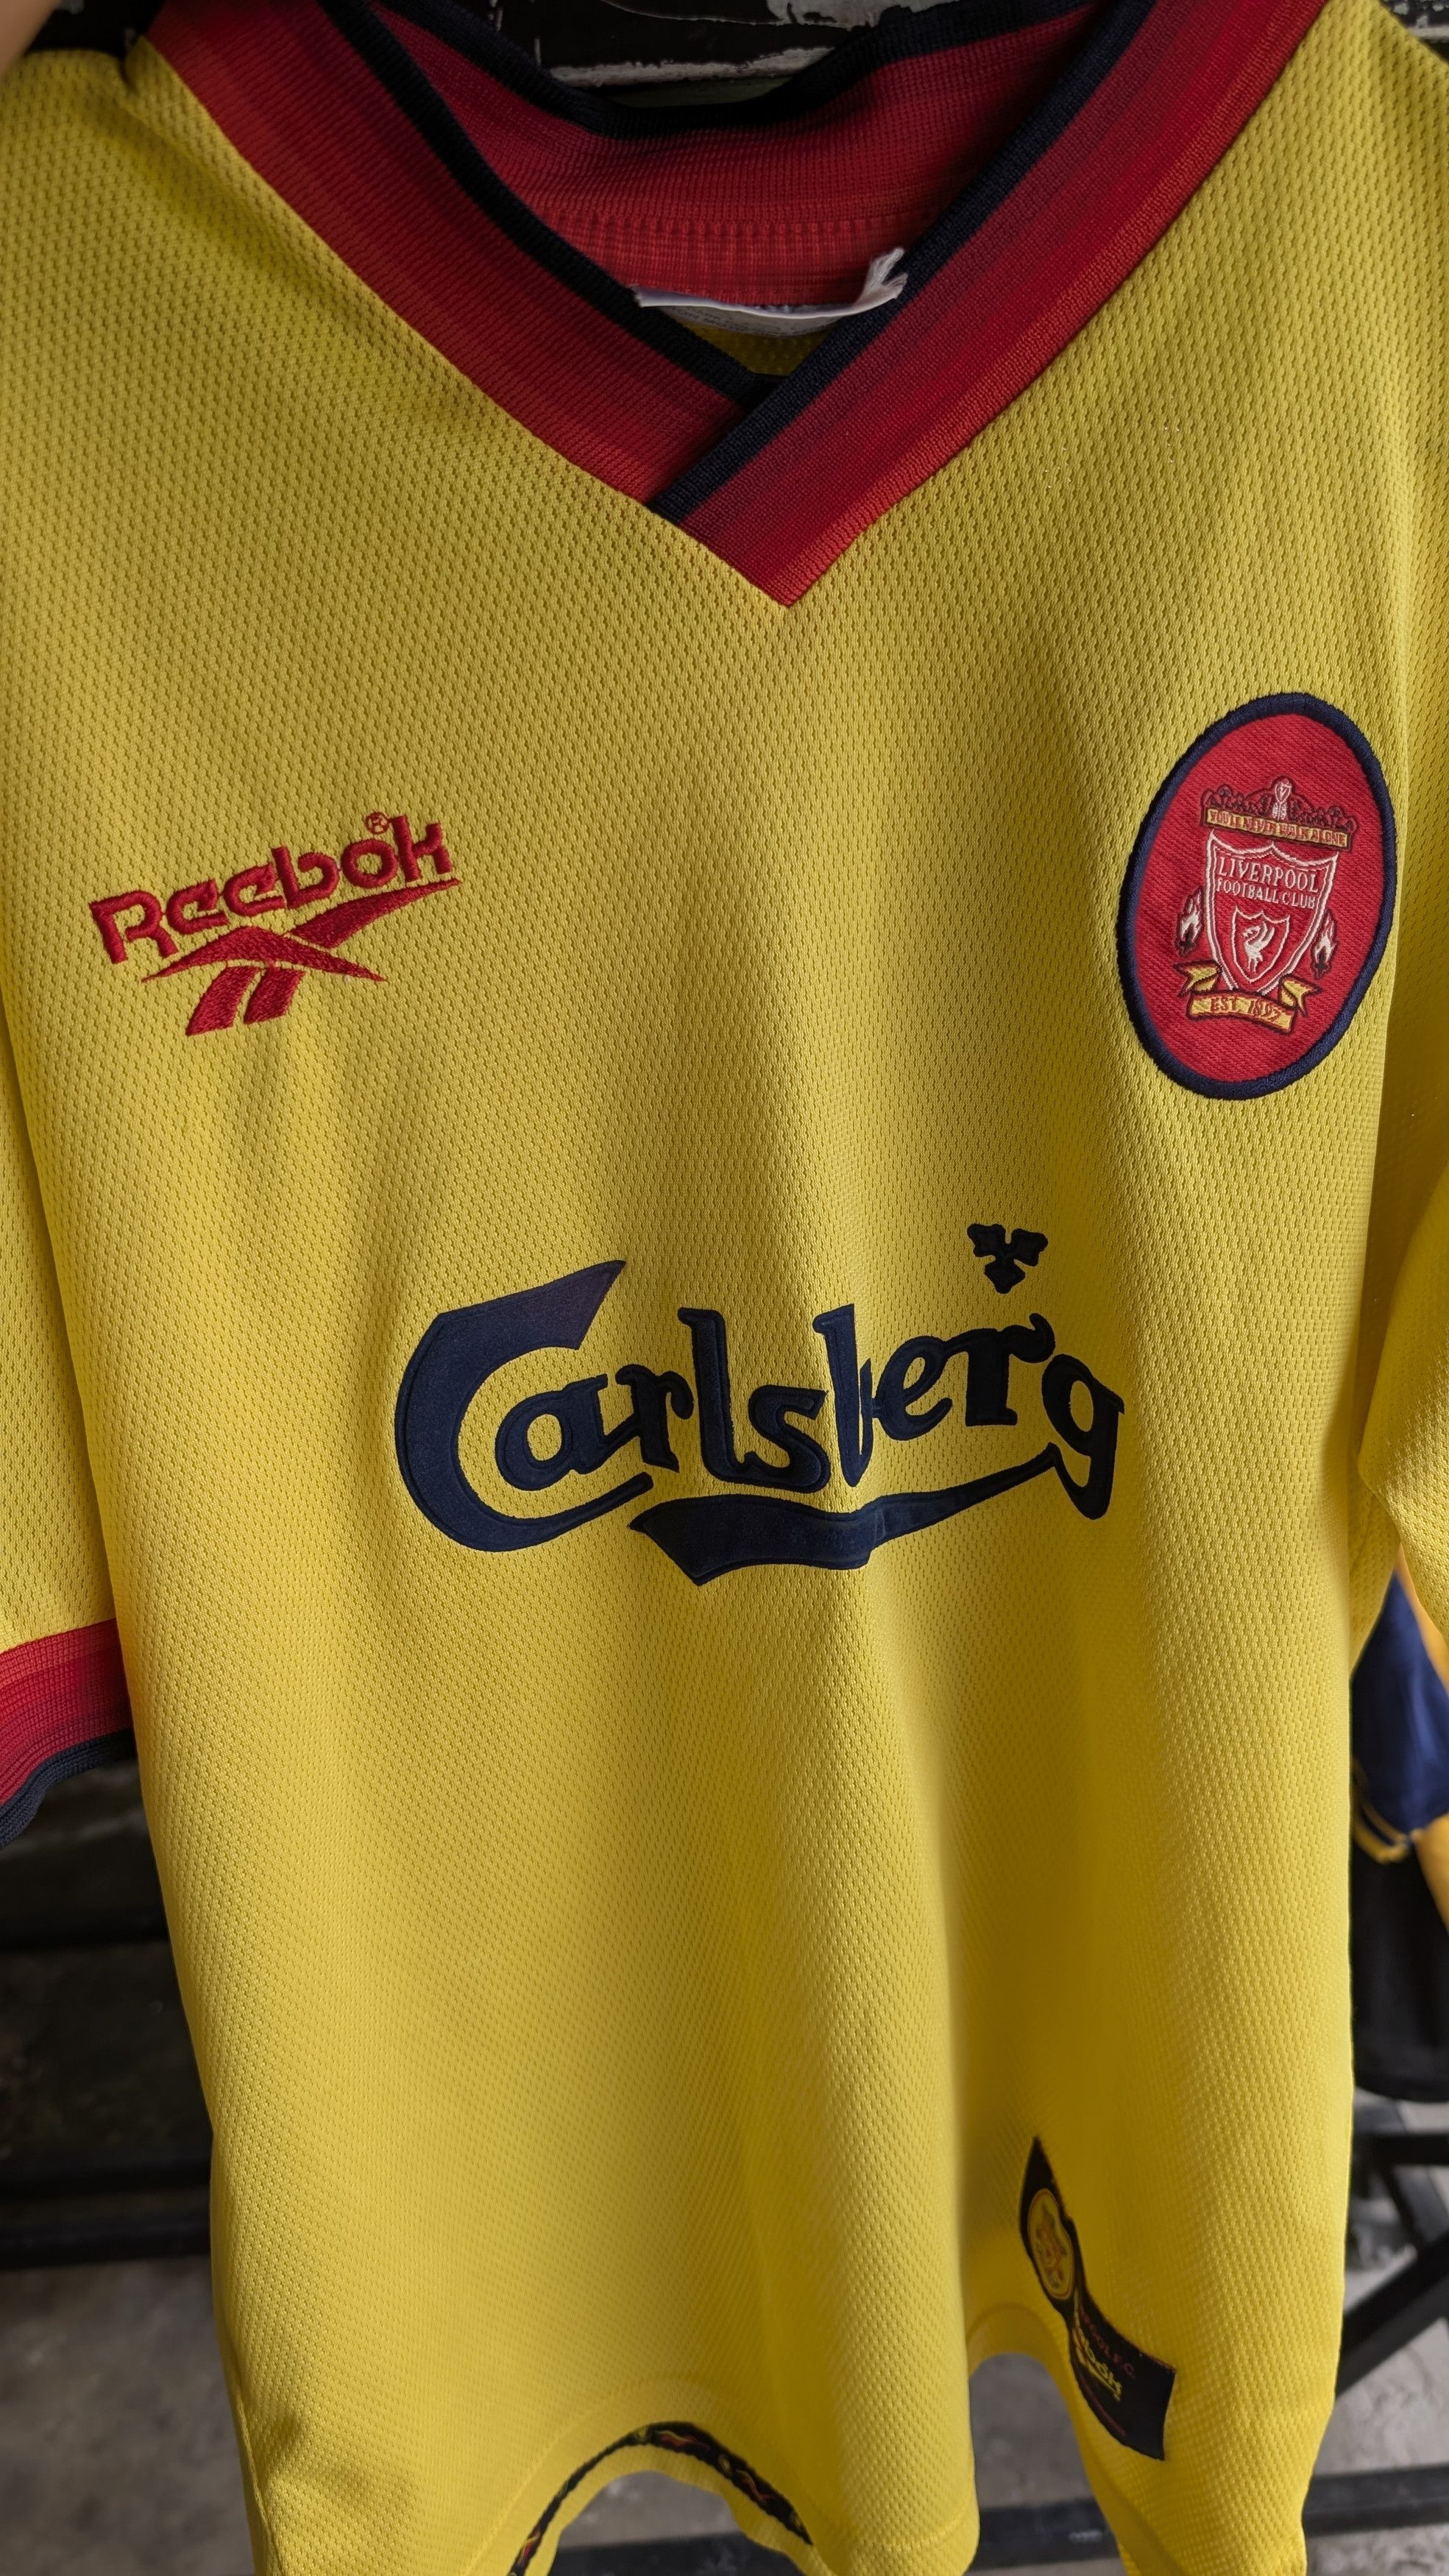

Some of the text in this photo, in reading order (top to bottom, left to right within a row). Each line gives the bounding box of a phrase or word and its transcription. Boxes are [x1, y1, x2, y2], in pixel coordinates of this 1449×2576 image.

[1310, 828, 1346, 846] ALONE
[88, 814, 453, 965] Reebok
[1218, 857, 1319, 894] LIVERPOOL
[1216, 877, 1316, 909] FOOTBALL CLUB
[1247, 998, 1281, 1022] 1892
[394, 1260, 1125, 1585] Carlsberg
